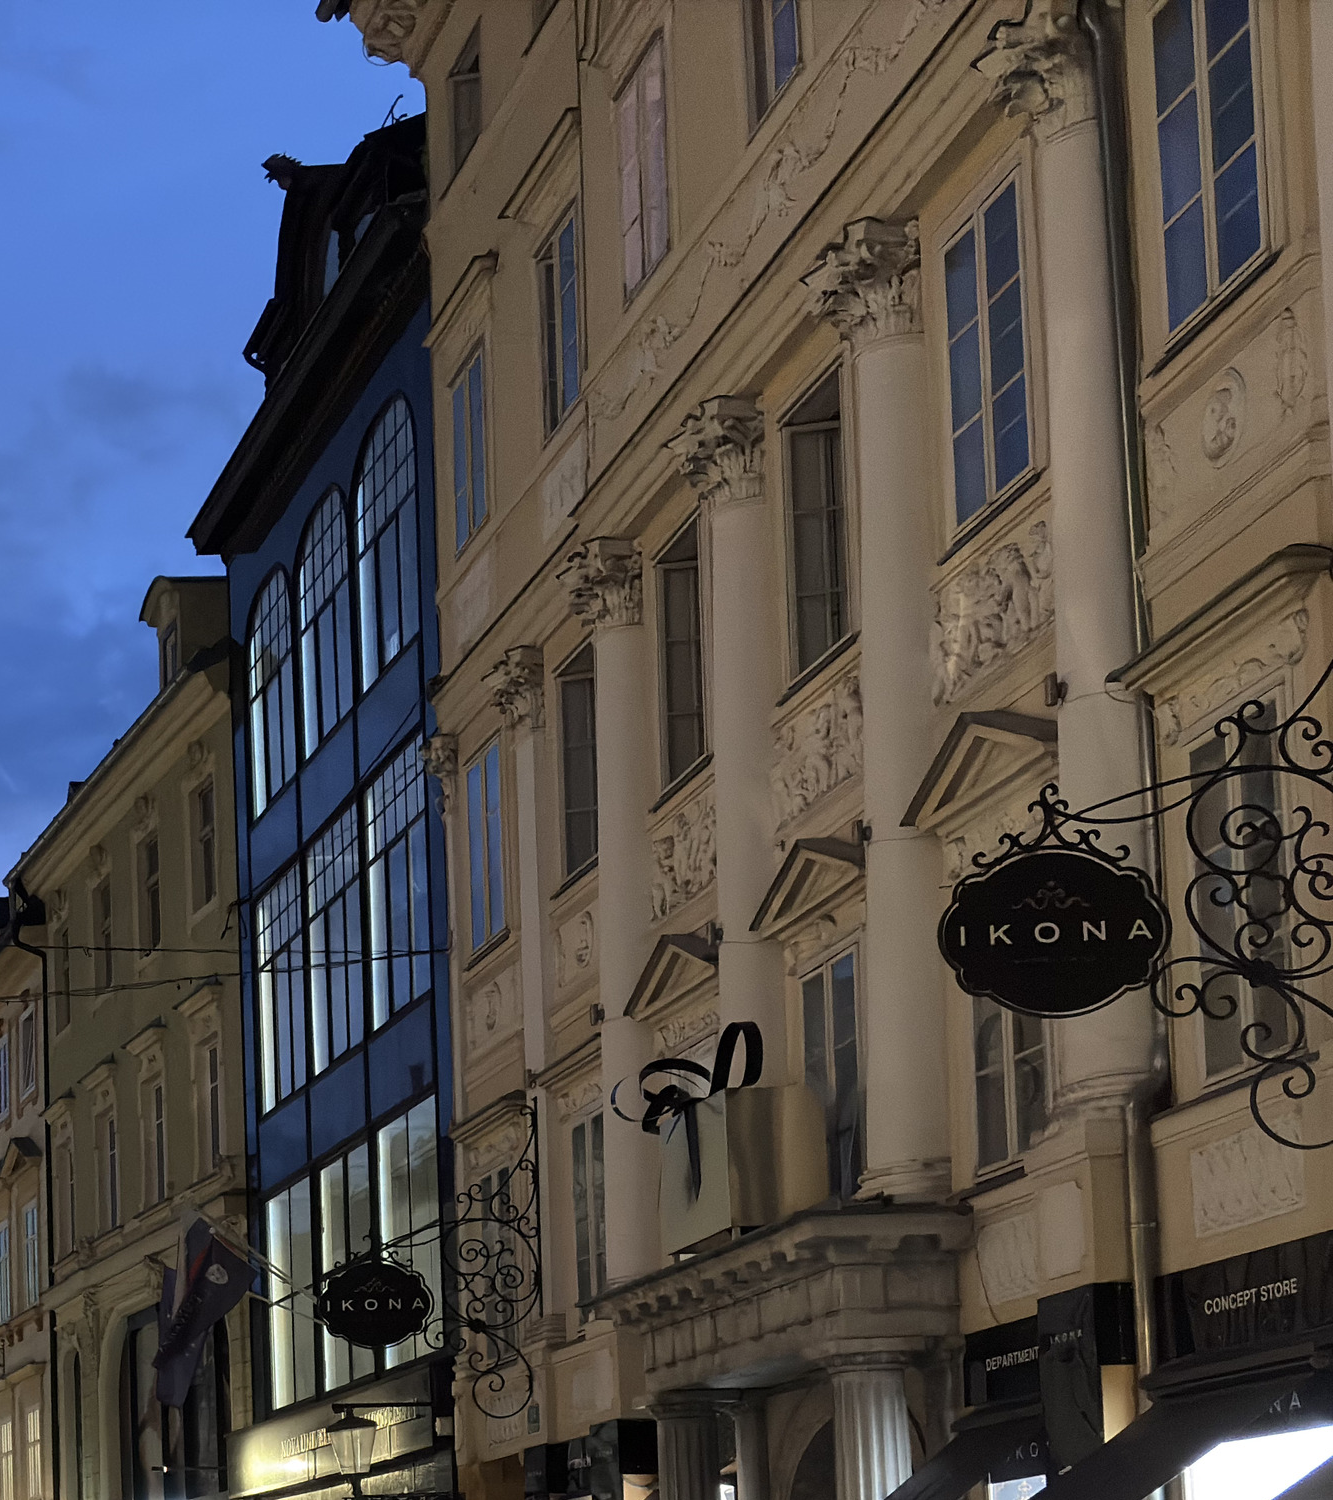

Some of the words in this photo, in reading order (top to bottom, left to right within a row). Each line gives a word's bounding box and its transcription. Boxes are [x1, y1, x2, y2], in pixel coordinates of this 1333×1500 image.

[959, 919, 1153, 947] IKONA
[326, 1298, 425, 1312] IKONA
[1204, 1288, 1257, 1315] CONCEPT
[1260, 1278, 1298, 1301] STORE
[1050, 1329, 1082, 1345] IKONA
[985, 1346, 1039, 1371] DEPARTMENT
